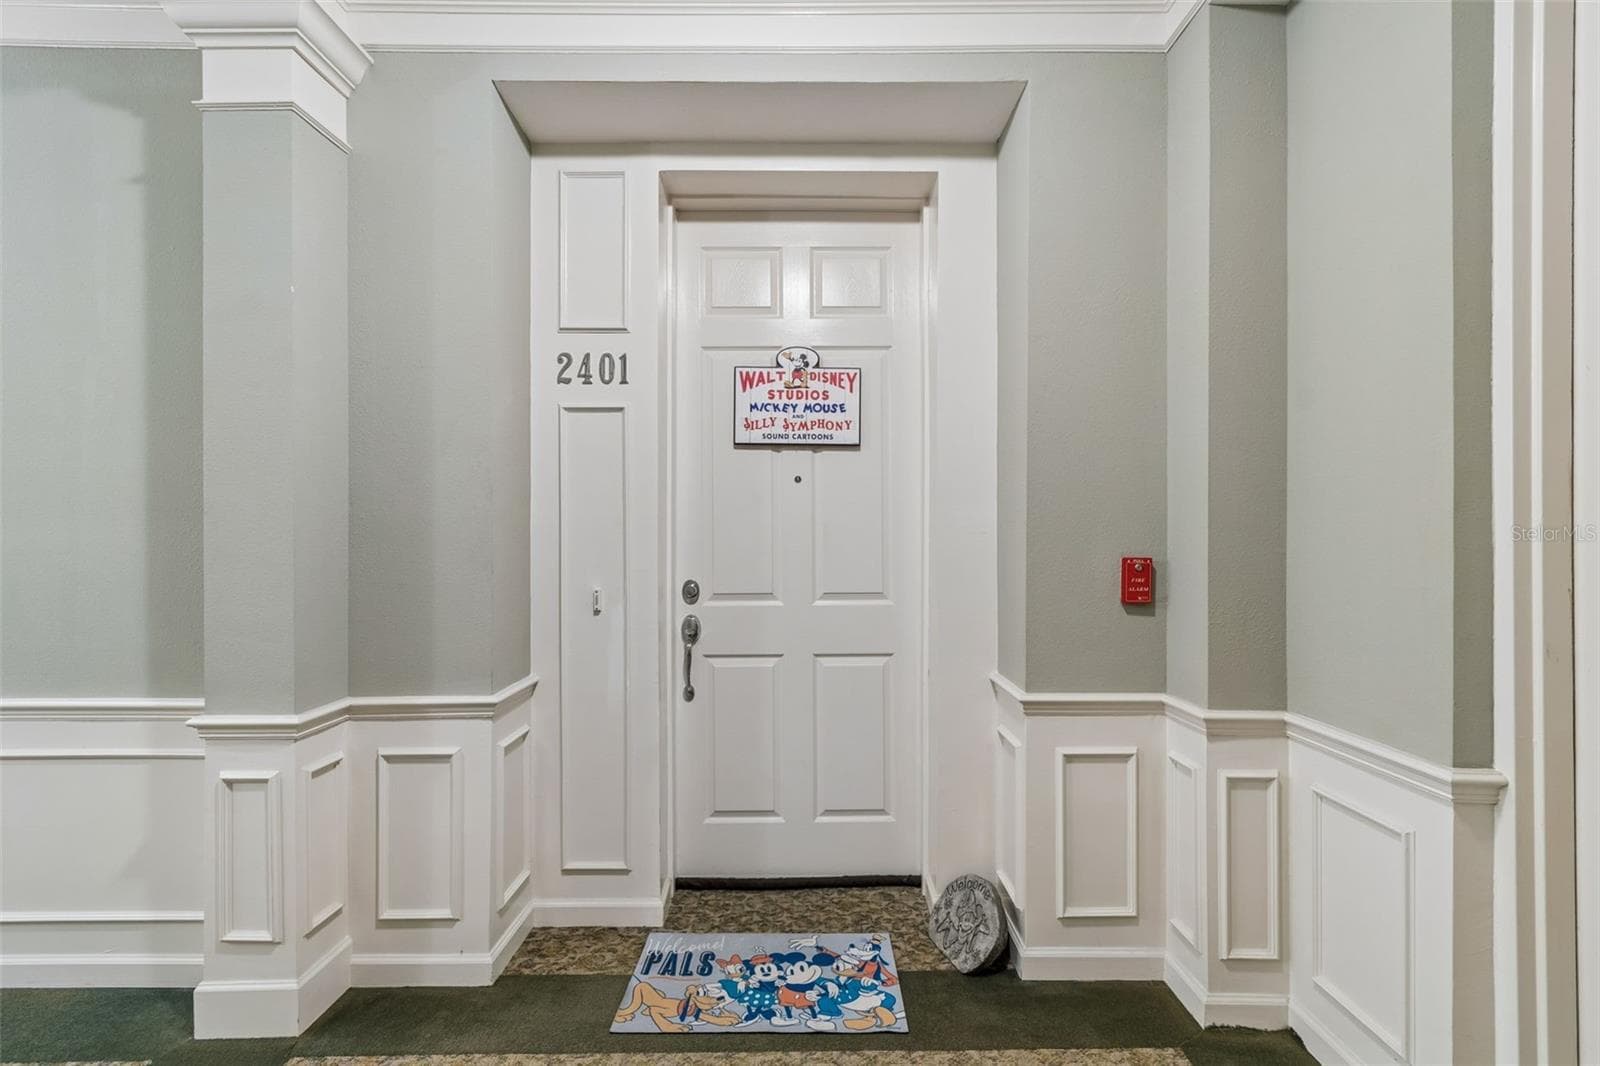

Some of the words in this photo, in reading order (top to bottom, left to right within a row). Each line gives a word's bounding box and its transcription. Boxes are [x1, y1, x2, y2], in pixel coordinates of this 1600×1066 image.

[557, 352, 629, 385] 2401
[739, 370, 786, 393] WALT
[809, 371, 858, 394] DISNEY
[767, 389, 830, 401] STUDIOS
[749, 402, 799, 414] MICKEY
[802, 402, 847, 414] MOUSE
[782, 416, 853, 432] SYMPHONY
[791, 433, 834, 441] CARTOONS
[641, 950, 716, 976] PALS
